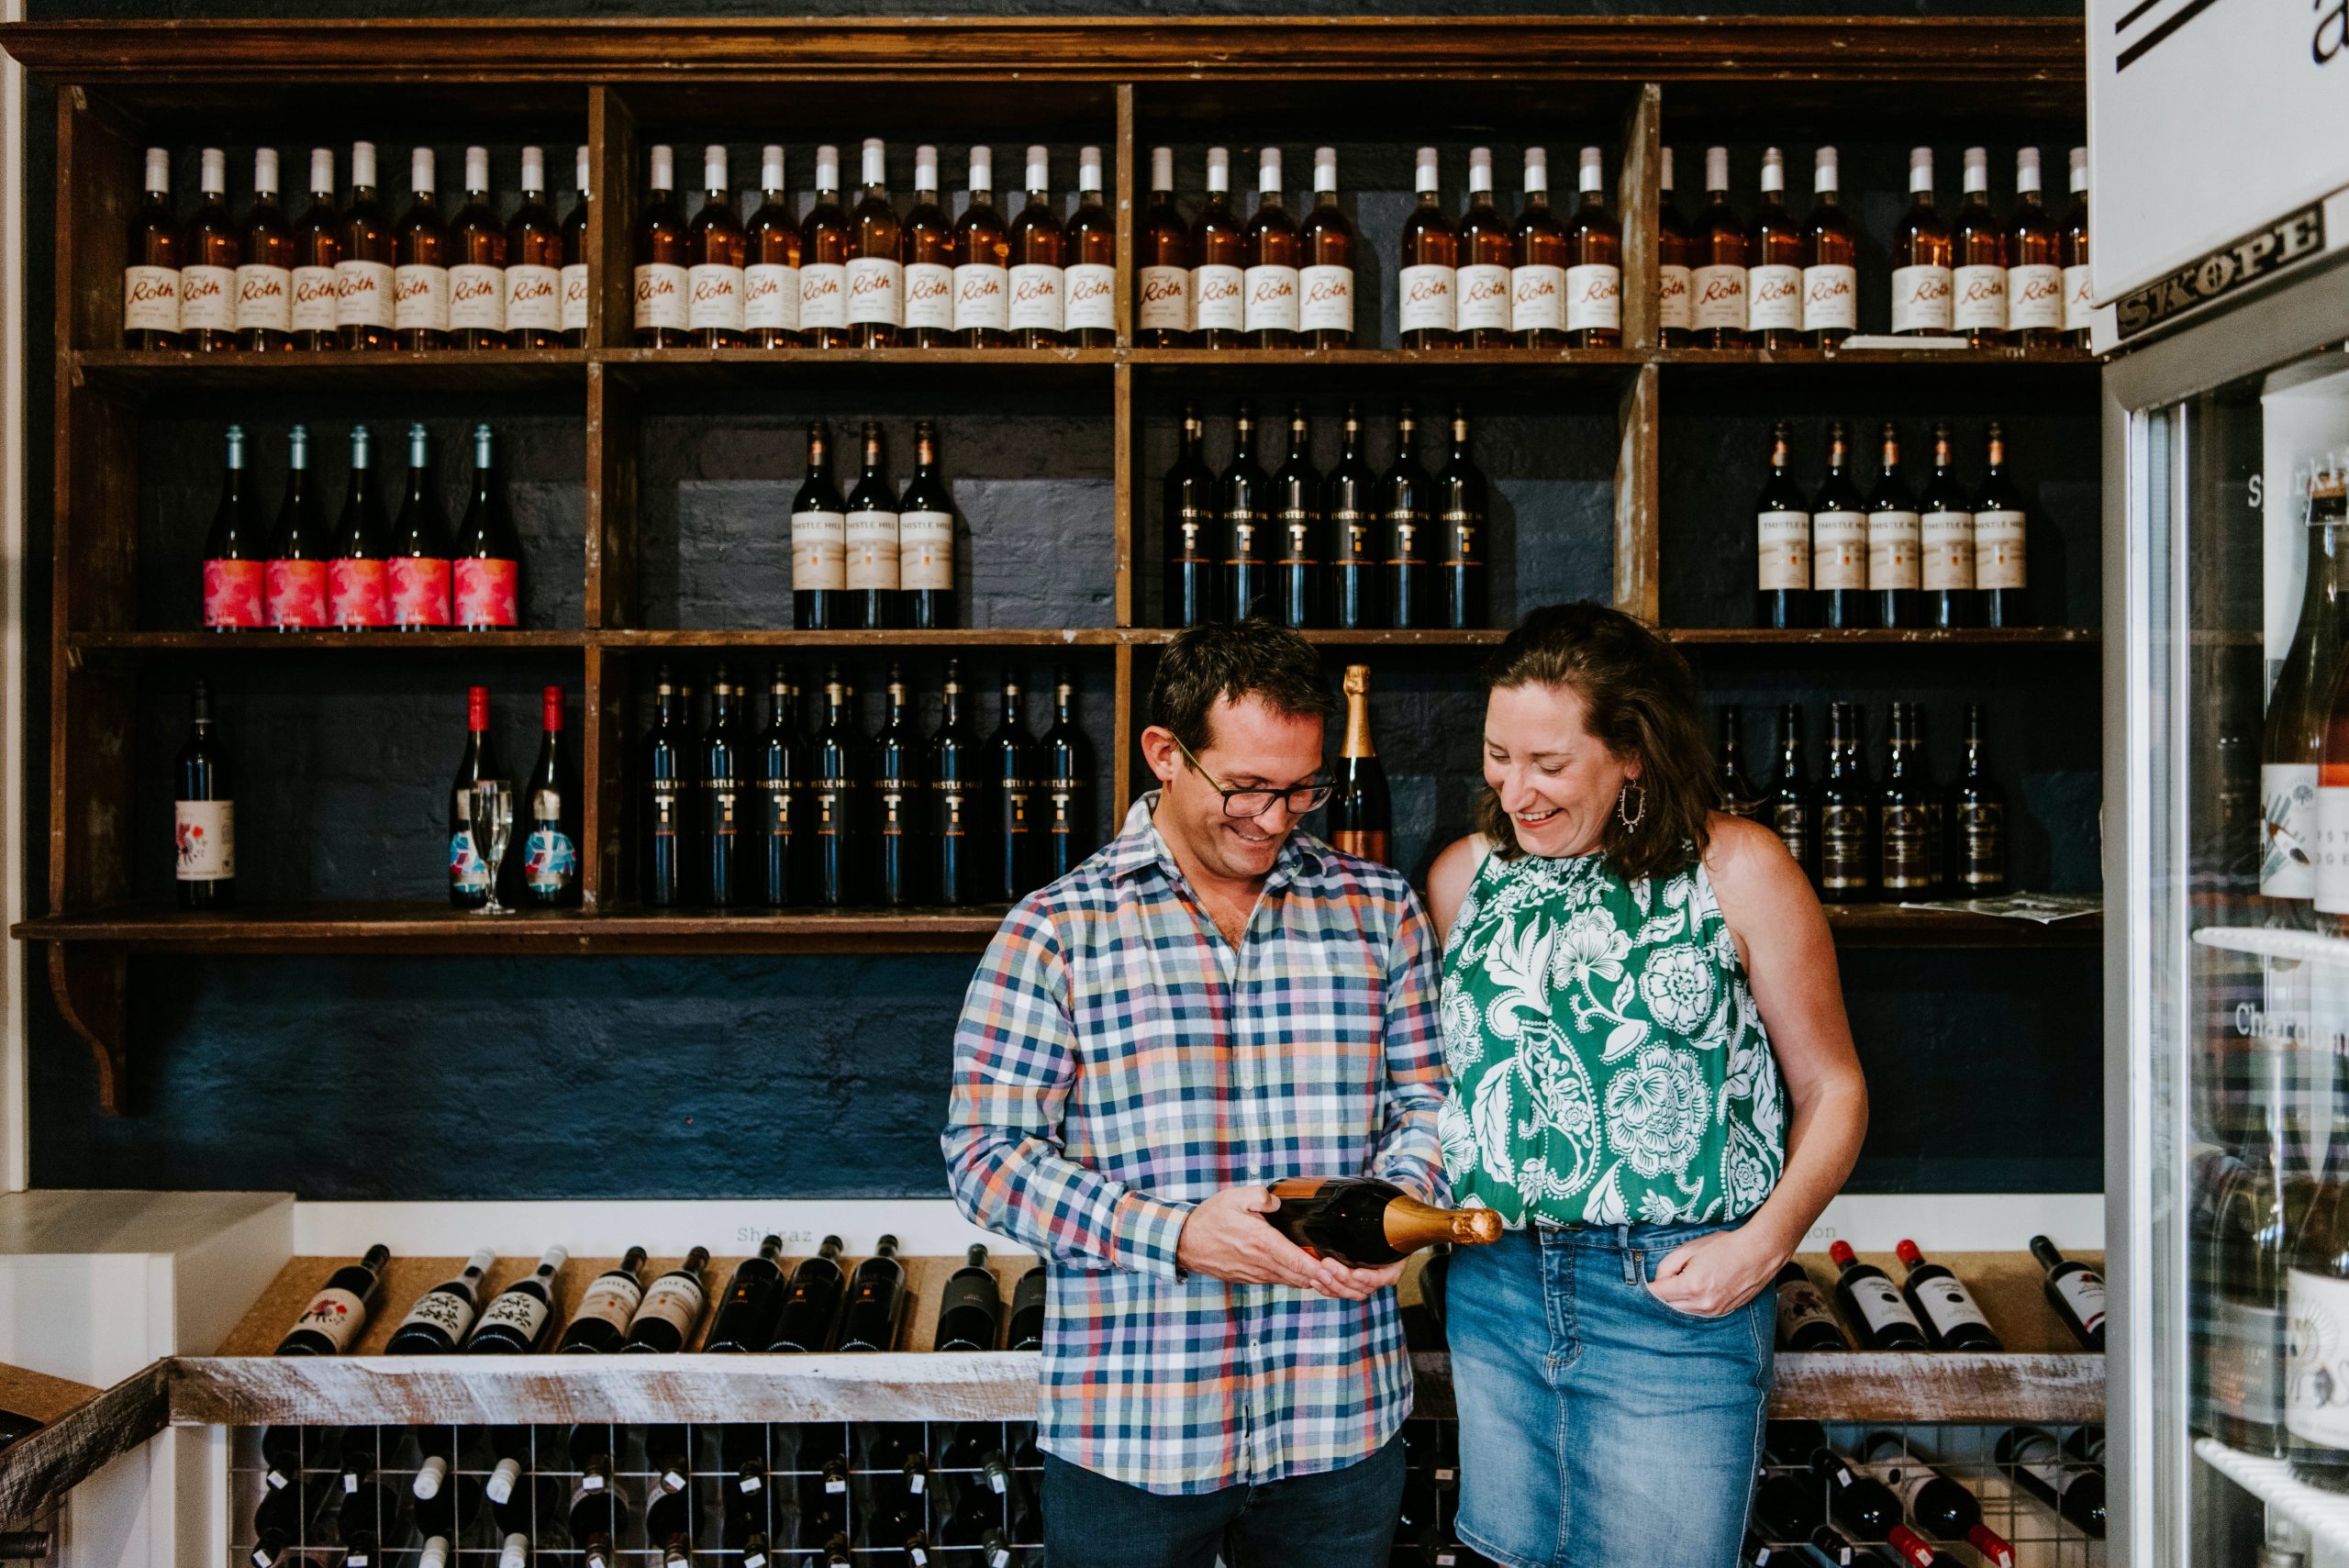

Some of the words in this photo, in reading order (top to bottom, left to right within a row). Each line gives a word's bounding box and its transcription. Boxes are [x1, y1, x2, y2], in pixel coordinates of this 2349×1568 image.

[2118, 208, 2319, 332] SKOPE
[128, 281, 174, 304] Roth
[239, 281, 282, 304] Roth
[293, 283, 335, 306] Roth
[334, 277, 375, 300] Roth
[451, 281, 494, 305] Roth
[509, 281, 553, 305] Roth
[635, 279, 676, 304] Roth
[692, 279, 734, 305] Roth
[744, 279, 779, 302] Roth
[800, 279, 840, 305] Roth
[849, 274, 891, 298] Roth
[907, 280, 949, 303] Roth
[958, 279, 1000, 304] Roth
[1013, 280, 1055, 304] Roth
[1069, 280, 1110, 305] Roth
[1141, 281, 1182, 305] Roth
[1197, 281, 1239, 304] Roth
[1251, 281, 1292, 305] Roth
[1306, 281, 1347, 305] Roth
[1406, 281, 1447, 306] Roth
[1464, 281, 1506, 305] Roth
[1513, 280, 1554, 306] Roth
[1659, 281, 1686, 299] oth
[1700, 281, 1742, 305] Roth
[1754, 281, 1797, 305] Roth
[1805, 281, 1849, 306] Roth
